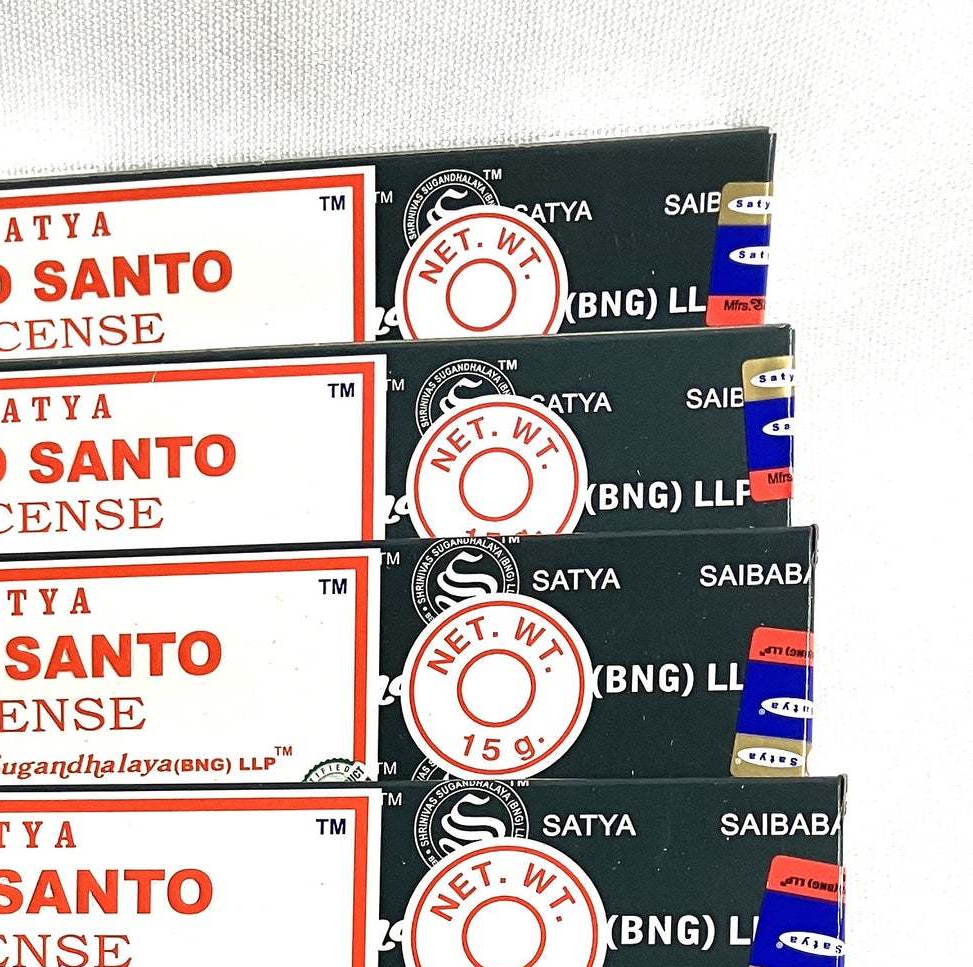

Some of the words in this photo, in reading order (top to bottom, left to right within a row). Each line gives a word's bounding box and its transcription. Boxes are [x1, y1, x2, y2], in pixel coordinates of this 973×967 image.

[483, 169, 501, 180] TM
[319, 195, 345, 211] TM
[34, 250, 232, 302] SANTO
[419, 228, 488, 289] NET.
[498, 229, 540, 279] WT.
[565, 287, 658, 325] (BNG)
[498, 360, 517, 370] TM
[328, 383, 354, 398] TM
[29, 434, 236, 484] SANTO
[431, 417, 503, 478] NET.
[513, 418, 558, 469] WT.
[584, 481, 681, 515] (BNG)
[318, 579, 347, 594] TM
[533, 568, 620, 591] SATYA
[5, 631, 222, 681] SANTO
[428, 617, 502, 680] NET.
[515, 618, 563, 672] WT.
[592, 662, 694, 700] (BNG)
[464, 735, 500, 761] 15
[316, 819, 346, 835] TM
[543, 814, 636, 836] SATYA
[430, 862, 512, 927] NET.
[518, 863, 575, 928] WT.
[605, 914, 715, 951] (BNG)
